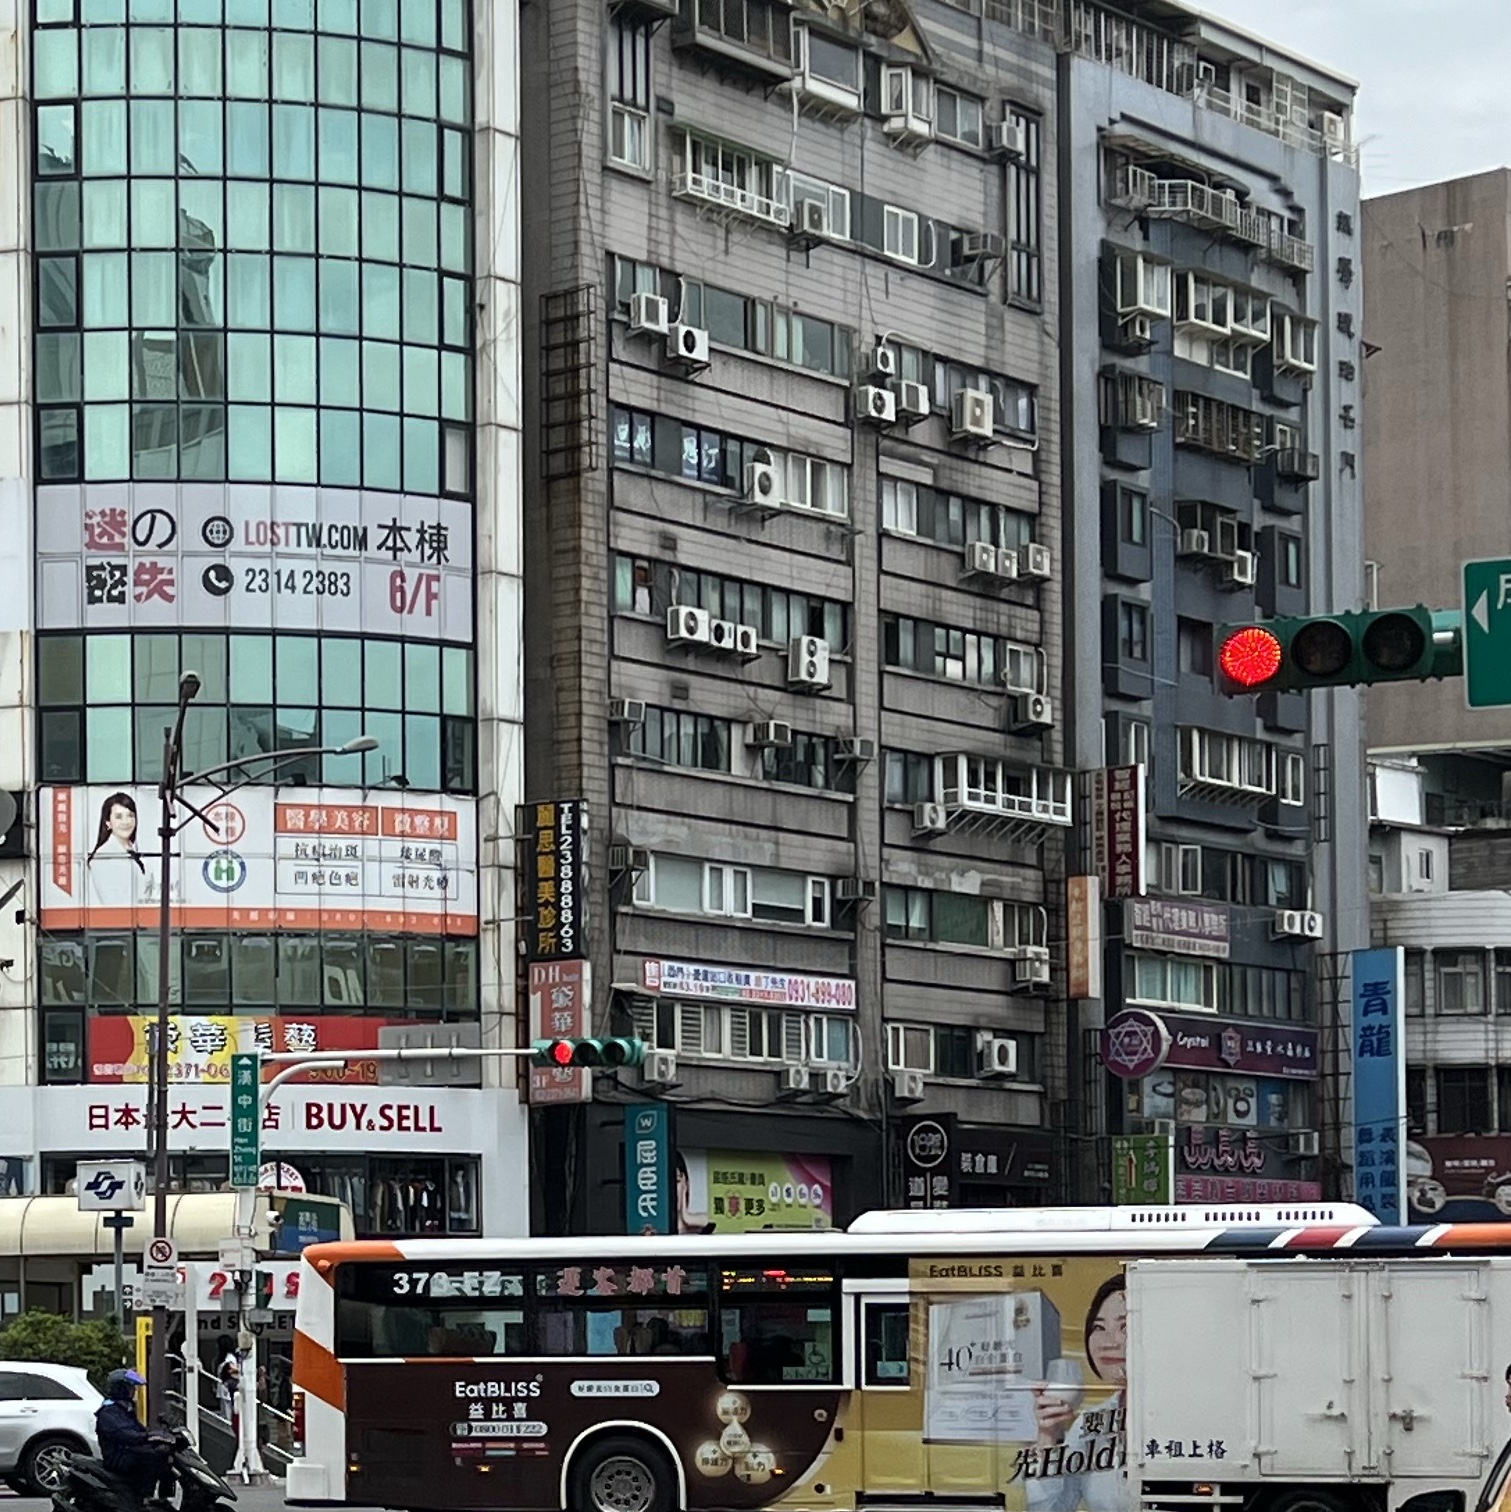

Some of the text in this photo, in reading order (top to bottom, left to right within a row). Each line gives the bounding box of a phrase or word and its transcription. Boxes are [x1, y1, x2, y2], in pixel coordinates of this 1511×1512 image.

[244, 519, 368, 552] LOSTTW.COM
[376, 517, 450, 565] 本棟
[388, 569, 442, 618] 6/F
[285, 808, 371, 831] 醫學美容
[1359, 981, 1392, 1058] 青龍
[237, 1069, 253, 1133] 漢中街
[88, 1102, 282, 1131] 日本大二店
[929, 1264, 1064, 1279] EatBLISS 益比喜
[455, 1382, 541, 1398] EatBLISS
[468, 1402, 528, 1419] 益比喜
